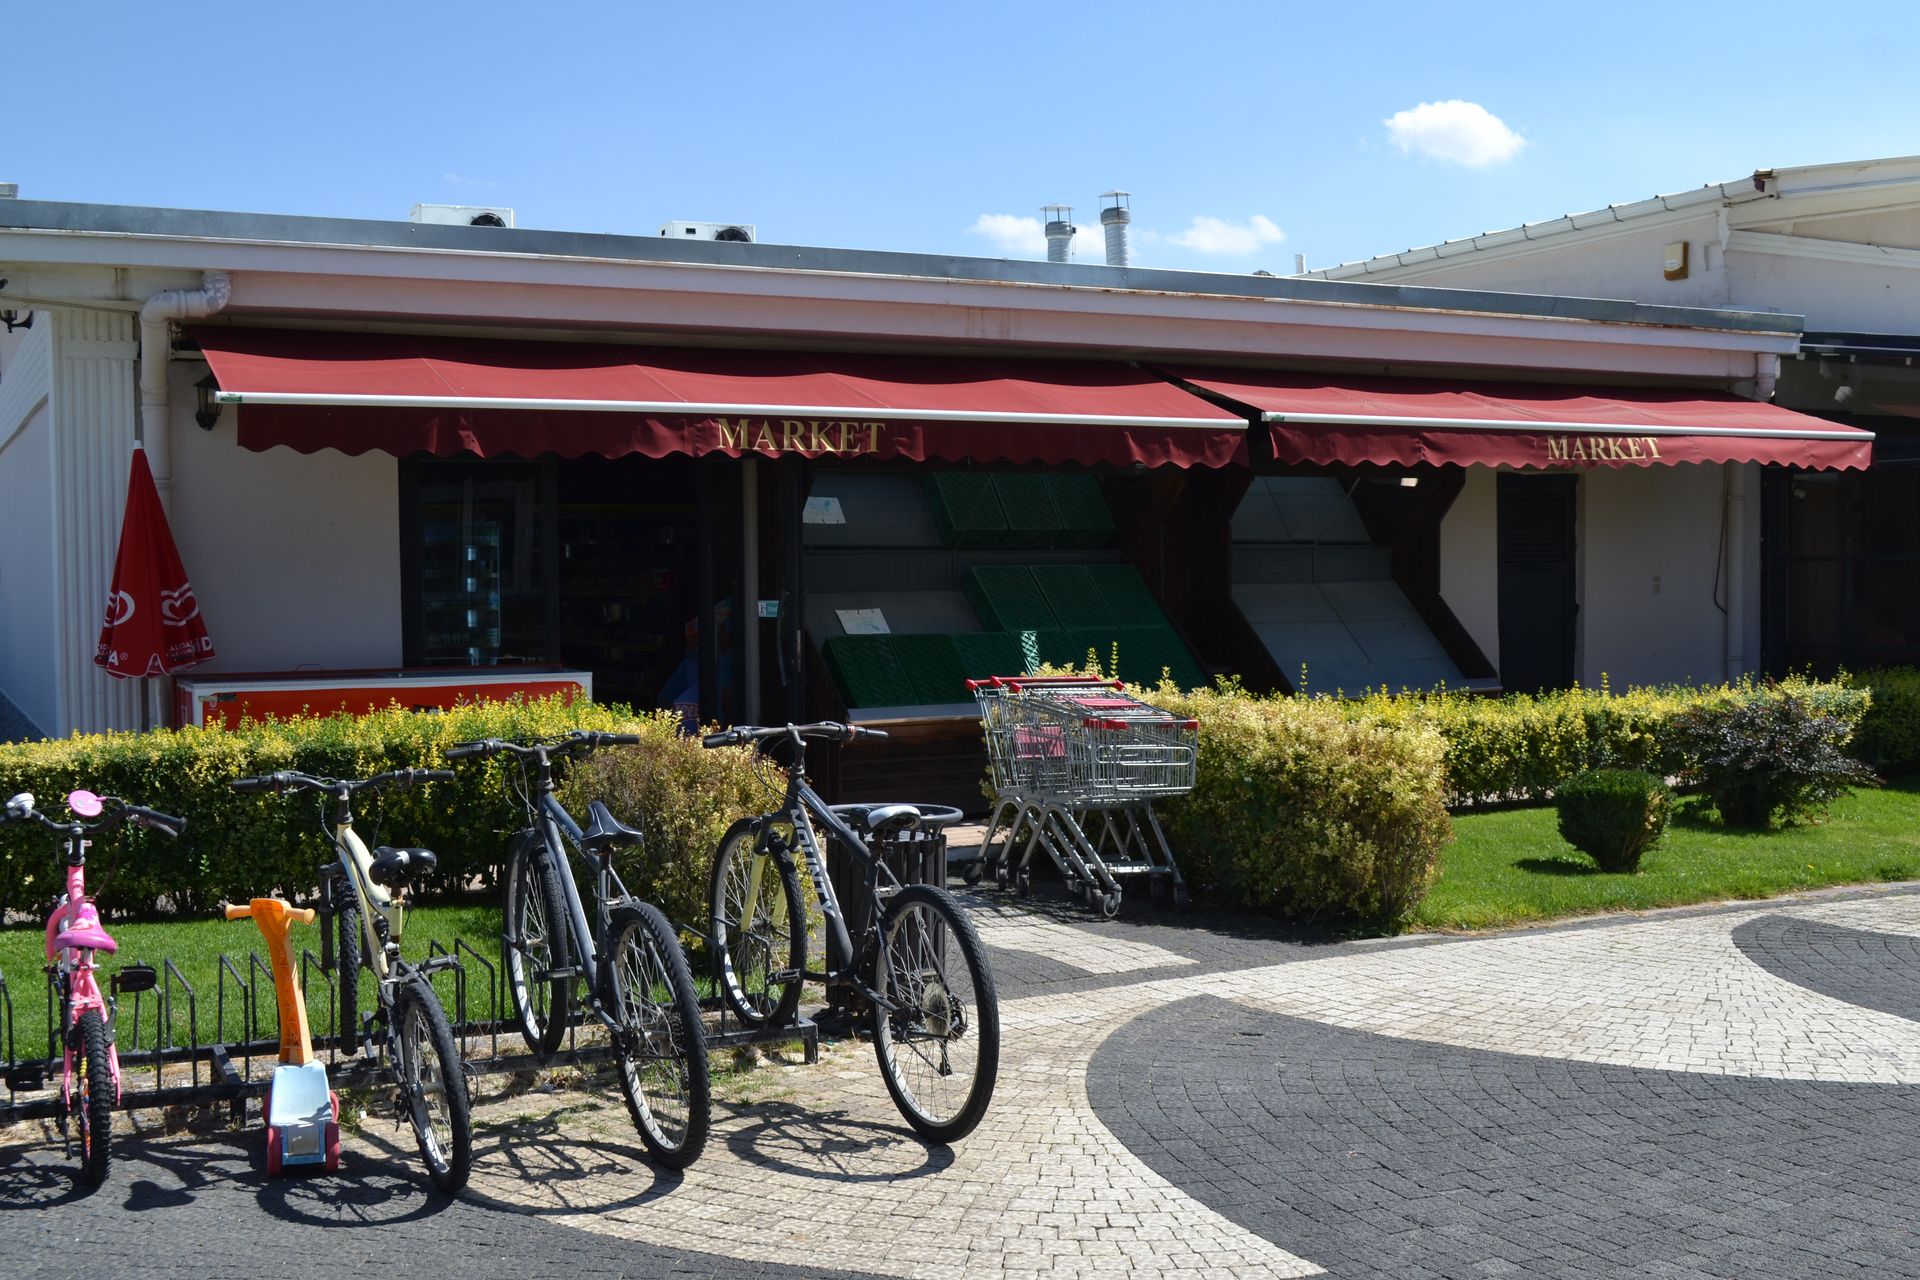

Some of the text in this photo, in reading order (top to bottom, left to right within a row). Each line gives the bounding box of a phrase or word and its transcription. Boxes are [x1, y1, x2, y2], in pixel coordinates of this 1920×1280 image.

[715, 418, 886, 452] MARKET
[1547, 435, 1662, 460] MARKET
[790, 809, 836, 917] MOUNTY
